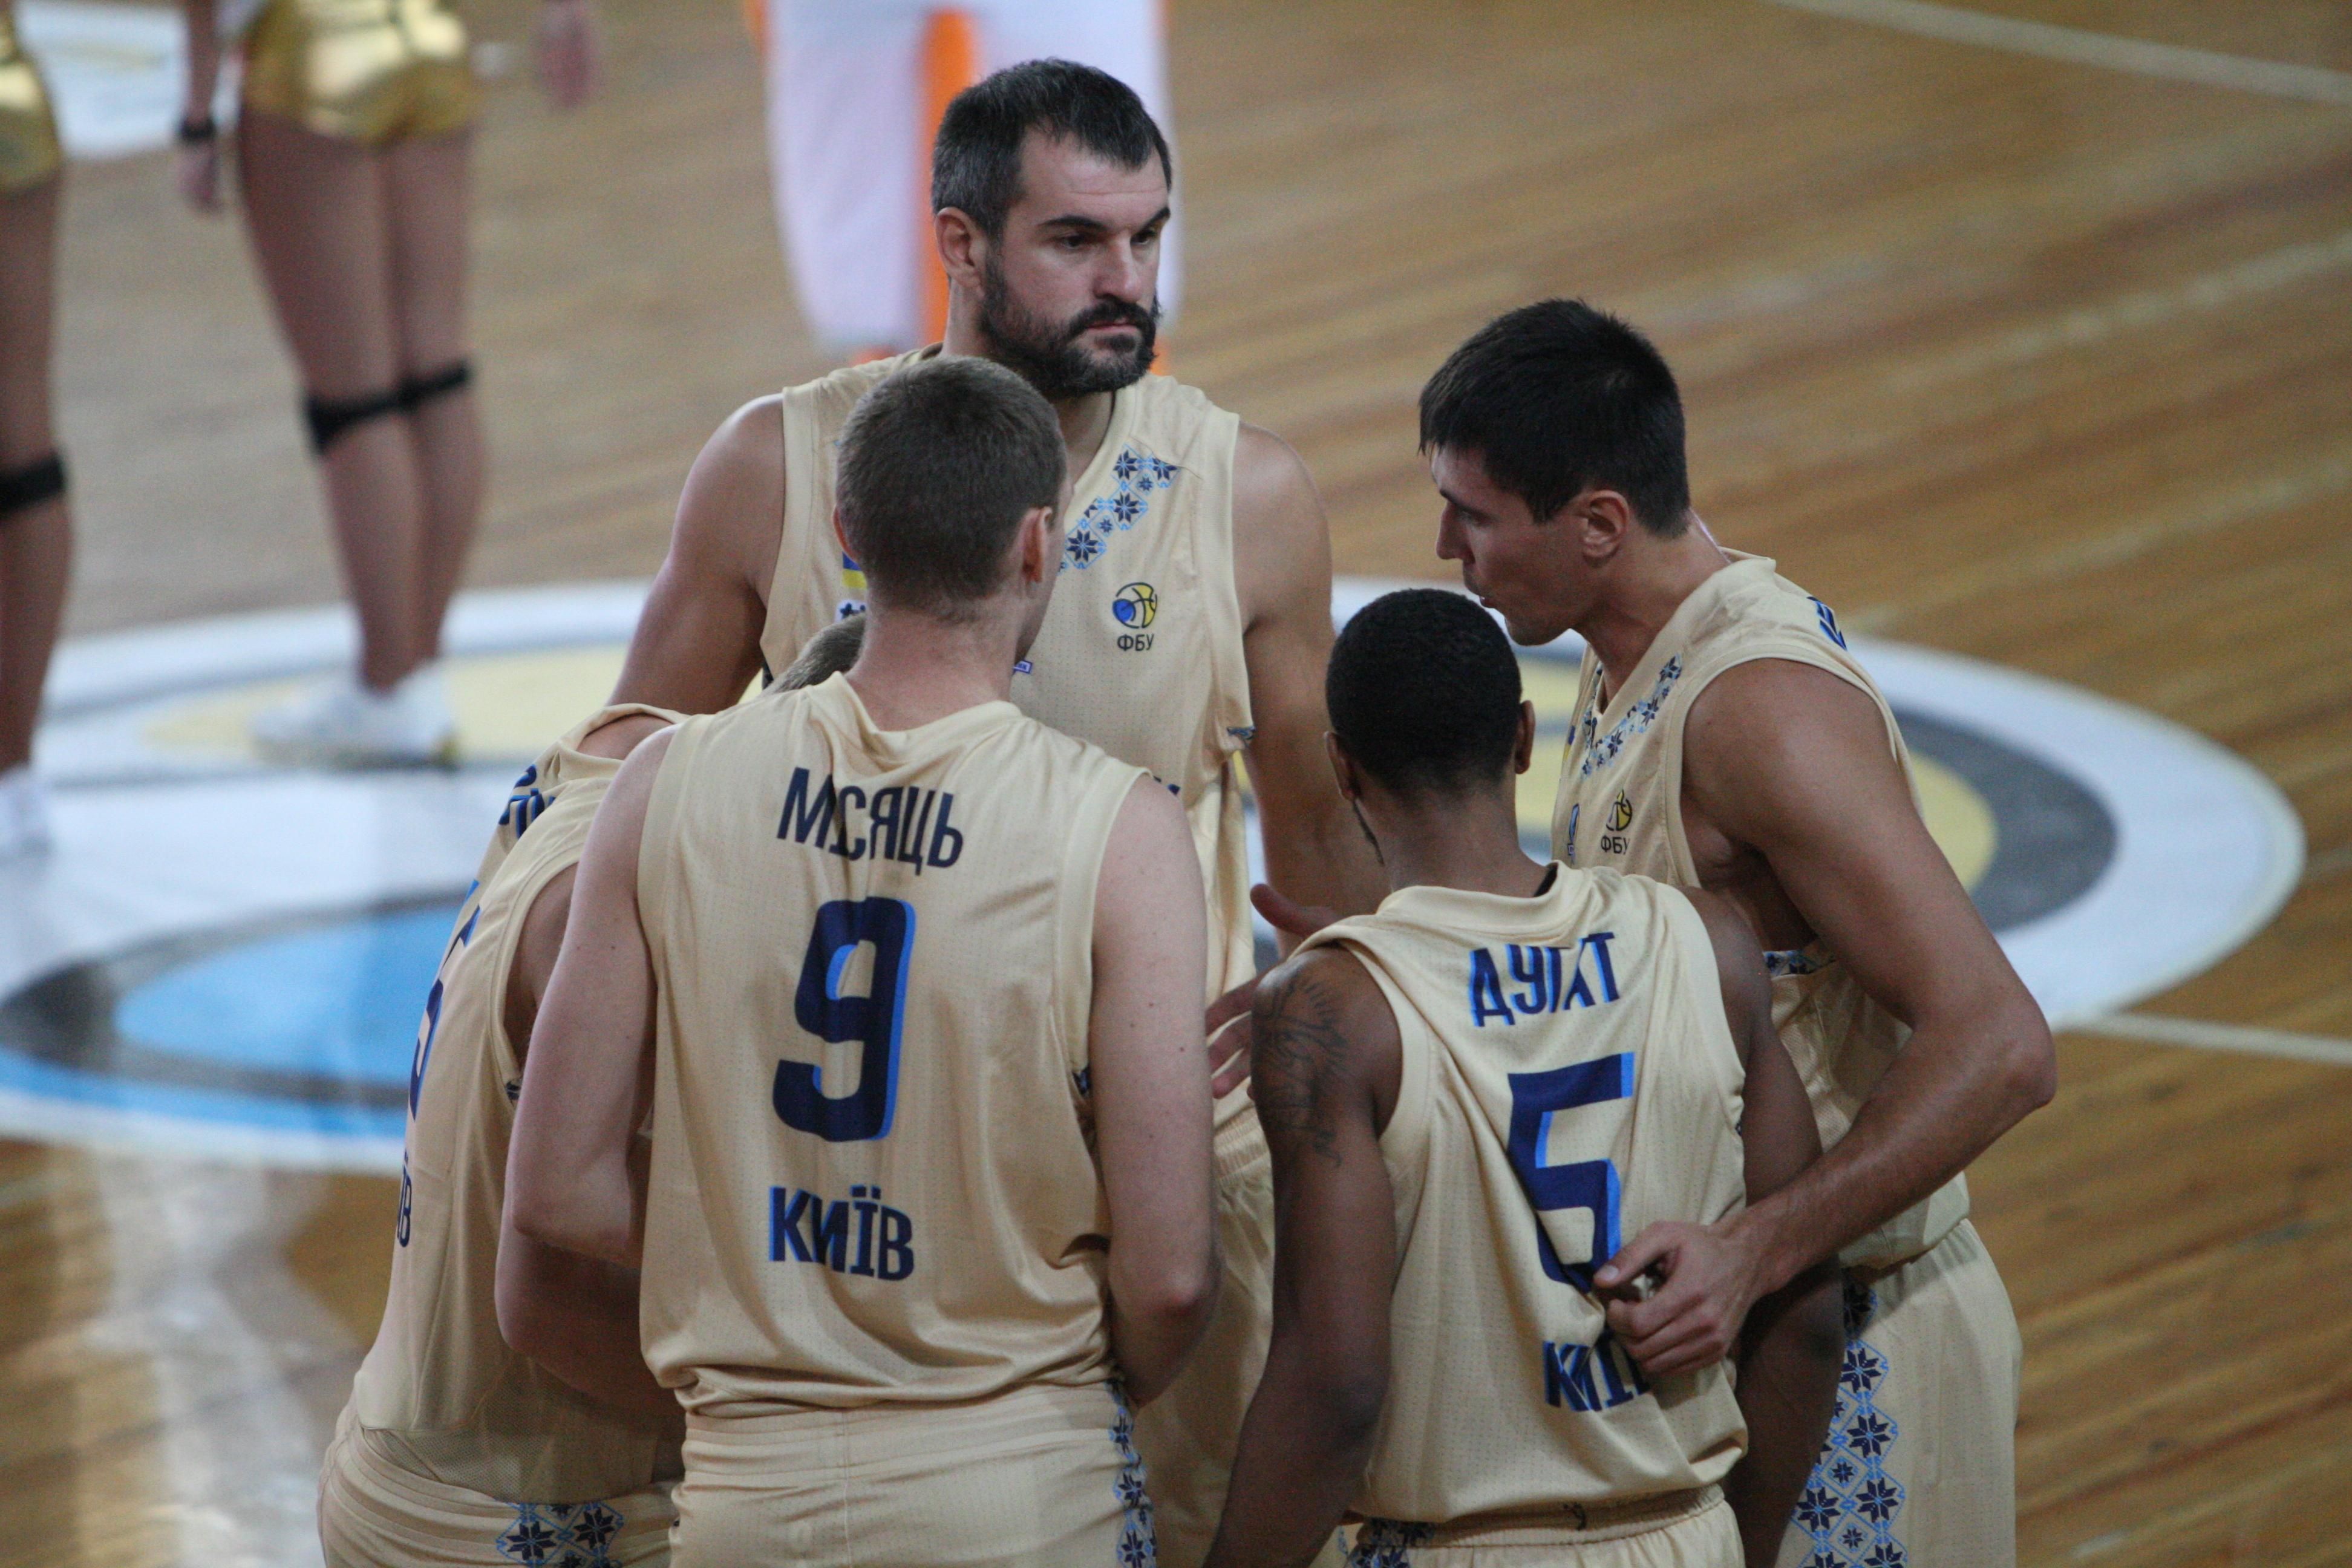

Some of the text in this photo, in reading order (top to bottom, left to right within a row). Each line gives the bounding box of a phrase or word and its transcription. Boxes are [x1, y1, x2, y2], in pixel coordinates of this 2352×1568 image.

[1117, 633, 1155, 652] ФБУ
[1601, 834, 1630, 855] ФБУ
[772, 896, 917, 1142] 9
[1507, 1051, 1635, 1294] 5
[769, 1184, 915, 1281] КИЇВ
